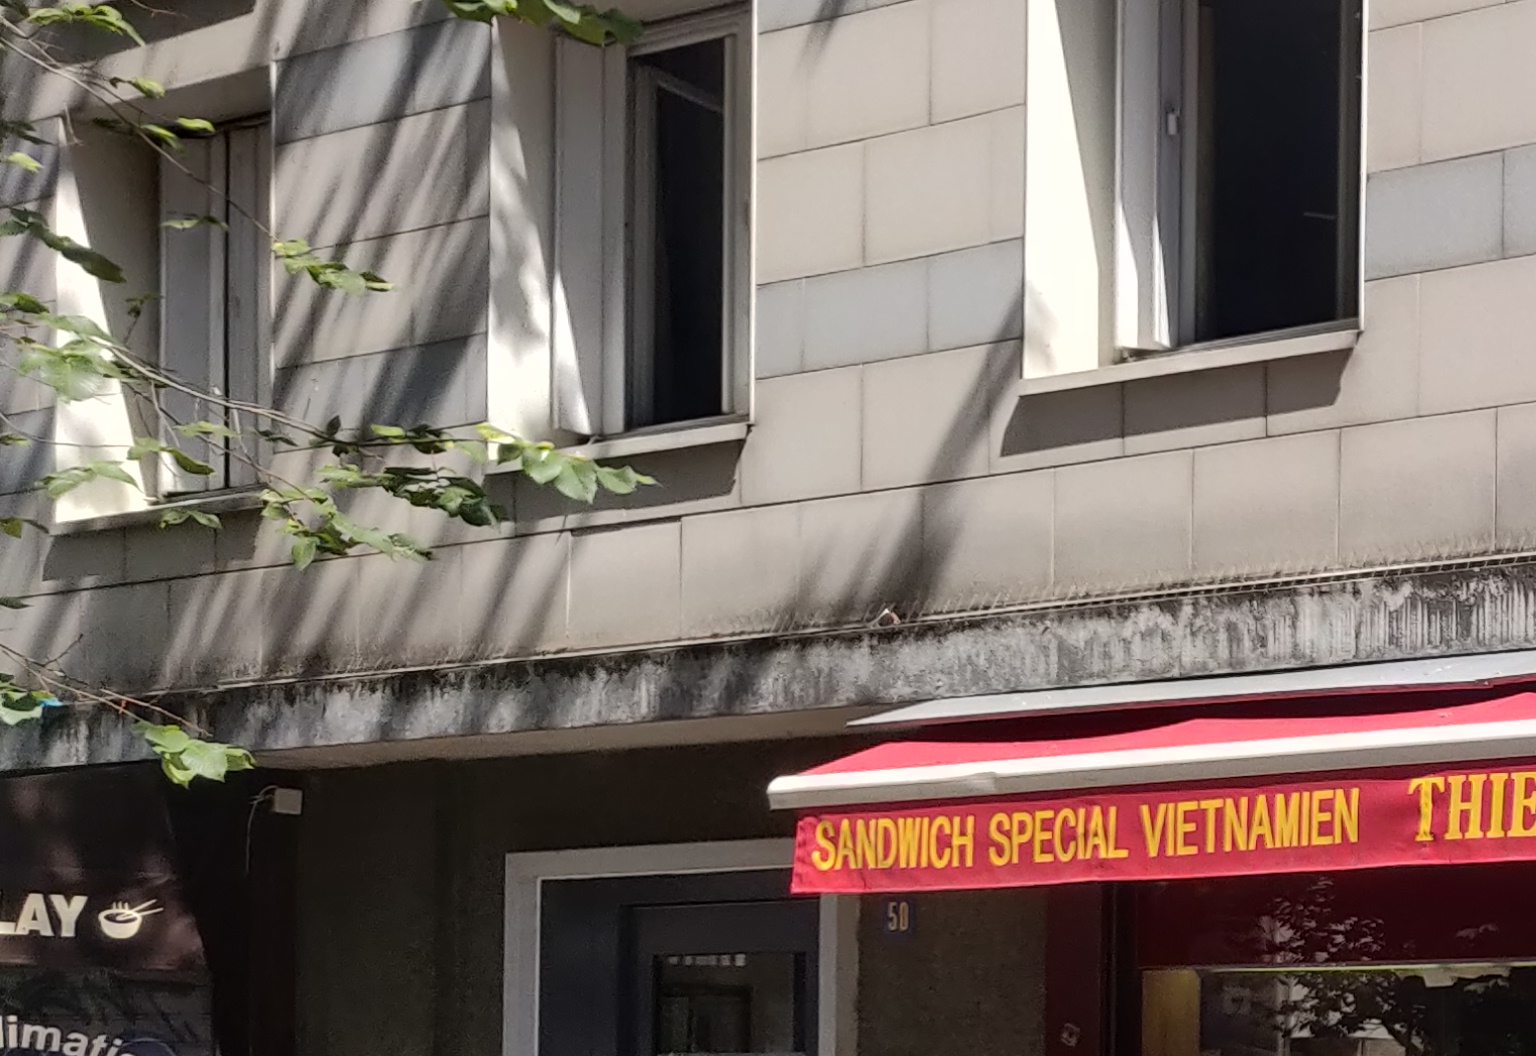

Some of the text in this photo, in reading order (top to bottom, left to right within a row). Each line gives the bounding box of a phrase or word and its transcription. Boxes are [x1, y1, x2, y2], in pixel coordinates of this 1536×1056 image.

[811, 817, 974, 870] SANDWICH
[988, 806, 1128, 866] SPECIAL
[1140, 787, 1360, 857] VIETNAMIEN
[887, 901, 910, 932] 50
